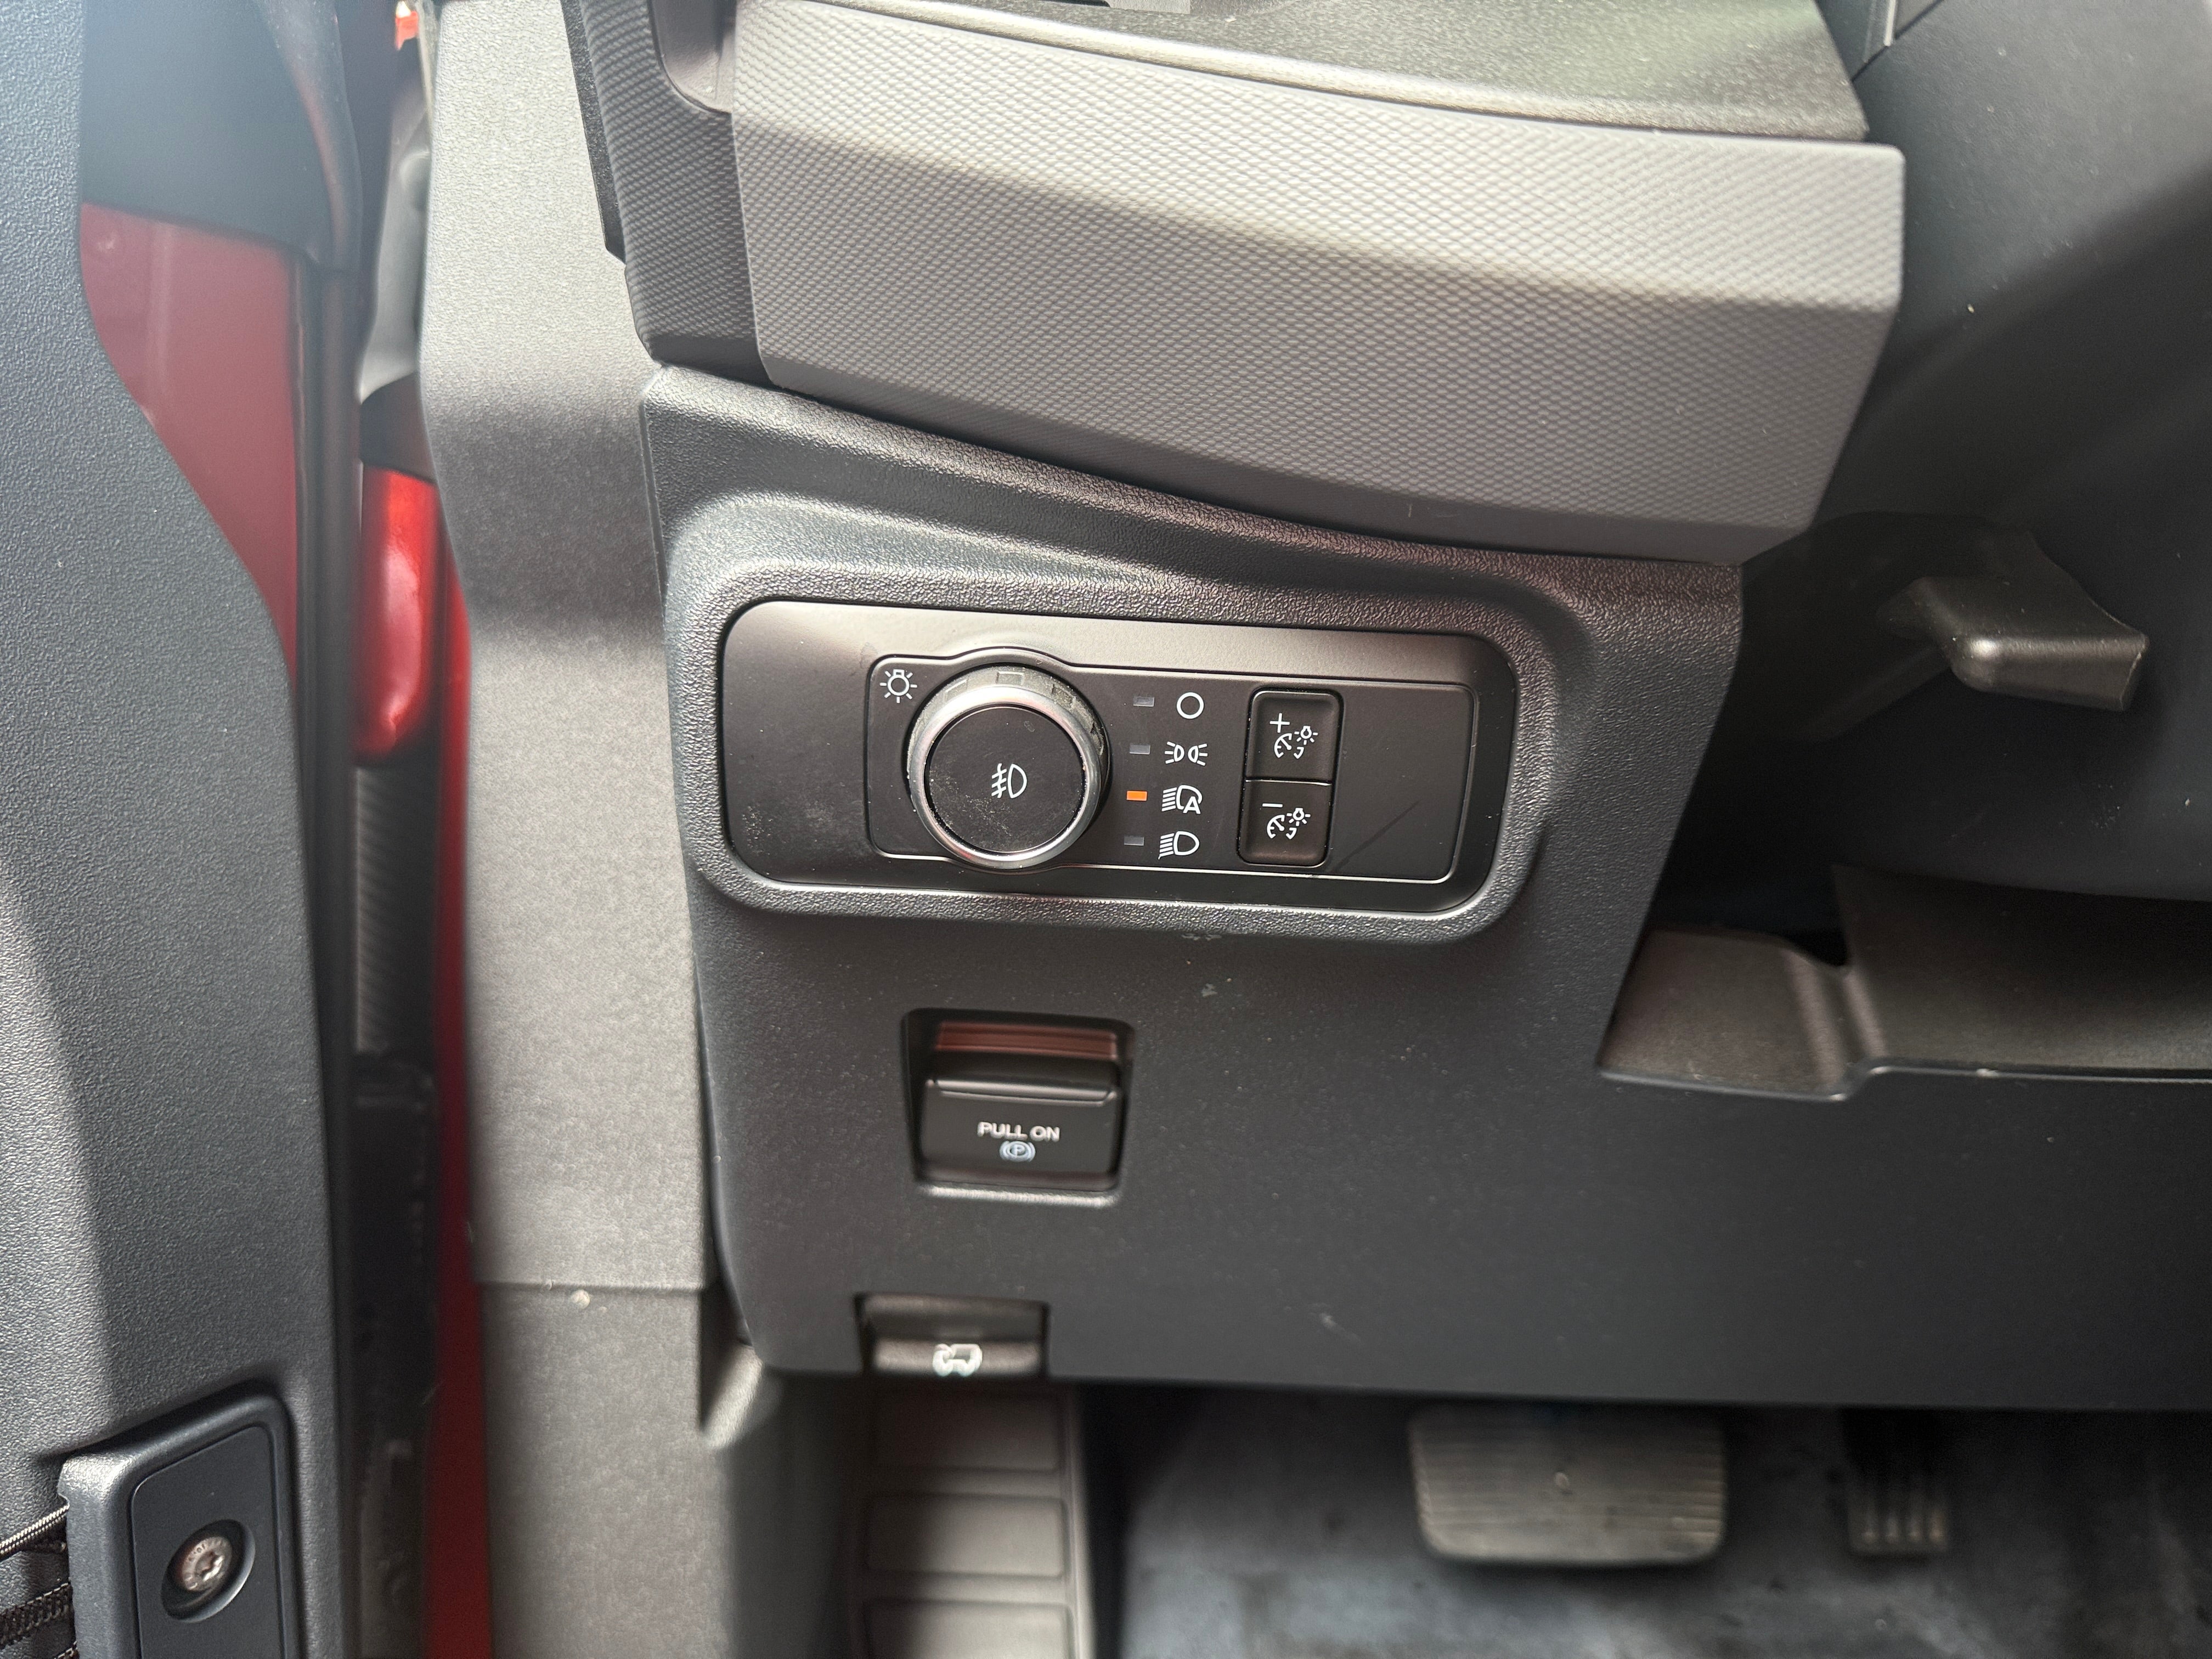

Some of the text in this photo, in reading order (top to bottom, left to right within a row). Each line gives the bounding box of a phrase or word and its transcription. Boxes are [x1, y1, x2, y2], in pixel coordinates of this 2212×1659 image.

[1183, 796, 1201, 814] A
[977, 1121, 1060, 1142] PULL ON
